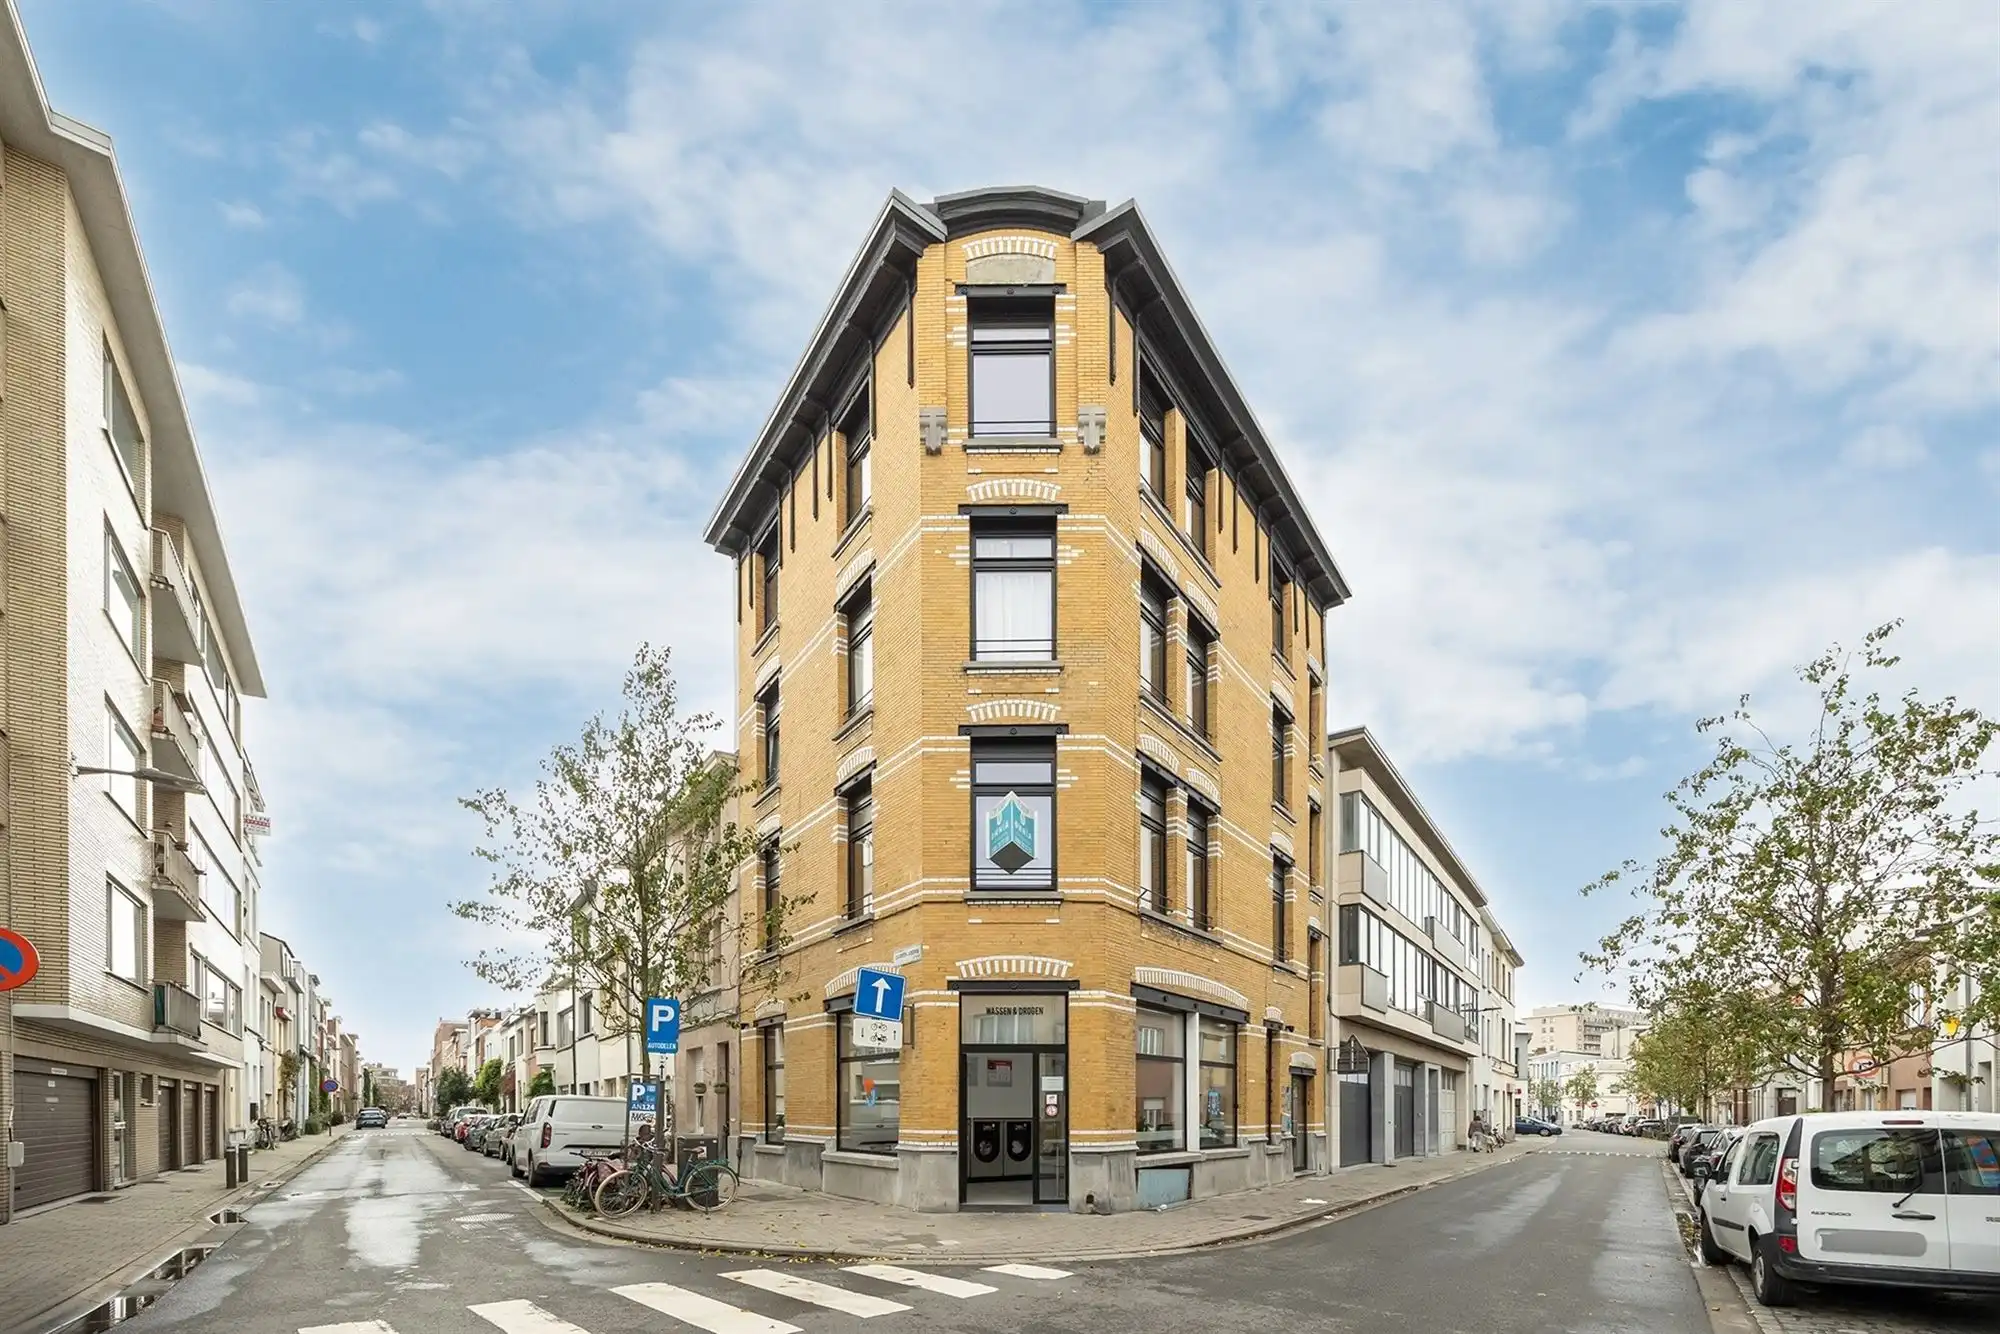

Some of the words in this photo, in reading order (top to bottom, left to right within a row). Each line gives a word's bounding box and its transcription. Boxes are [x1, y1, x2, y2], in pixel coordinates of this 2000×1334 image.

[652, 1004, 675, 1032] P
[985, 1006, 1012, 1016] WASSEN
[1012, 1006, 1018, 1016] &
[1018, 1006, 1045, 1016] DROGEN
[631, 1083, 646, 1101] P
